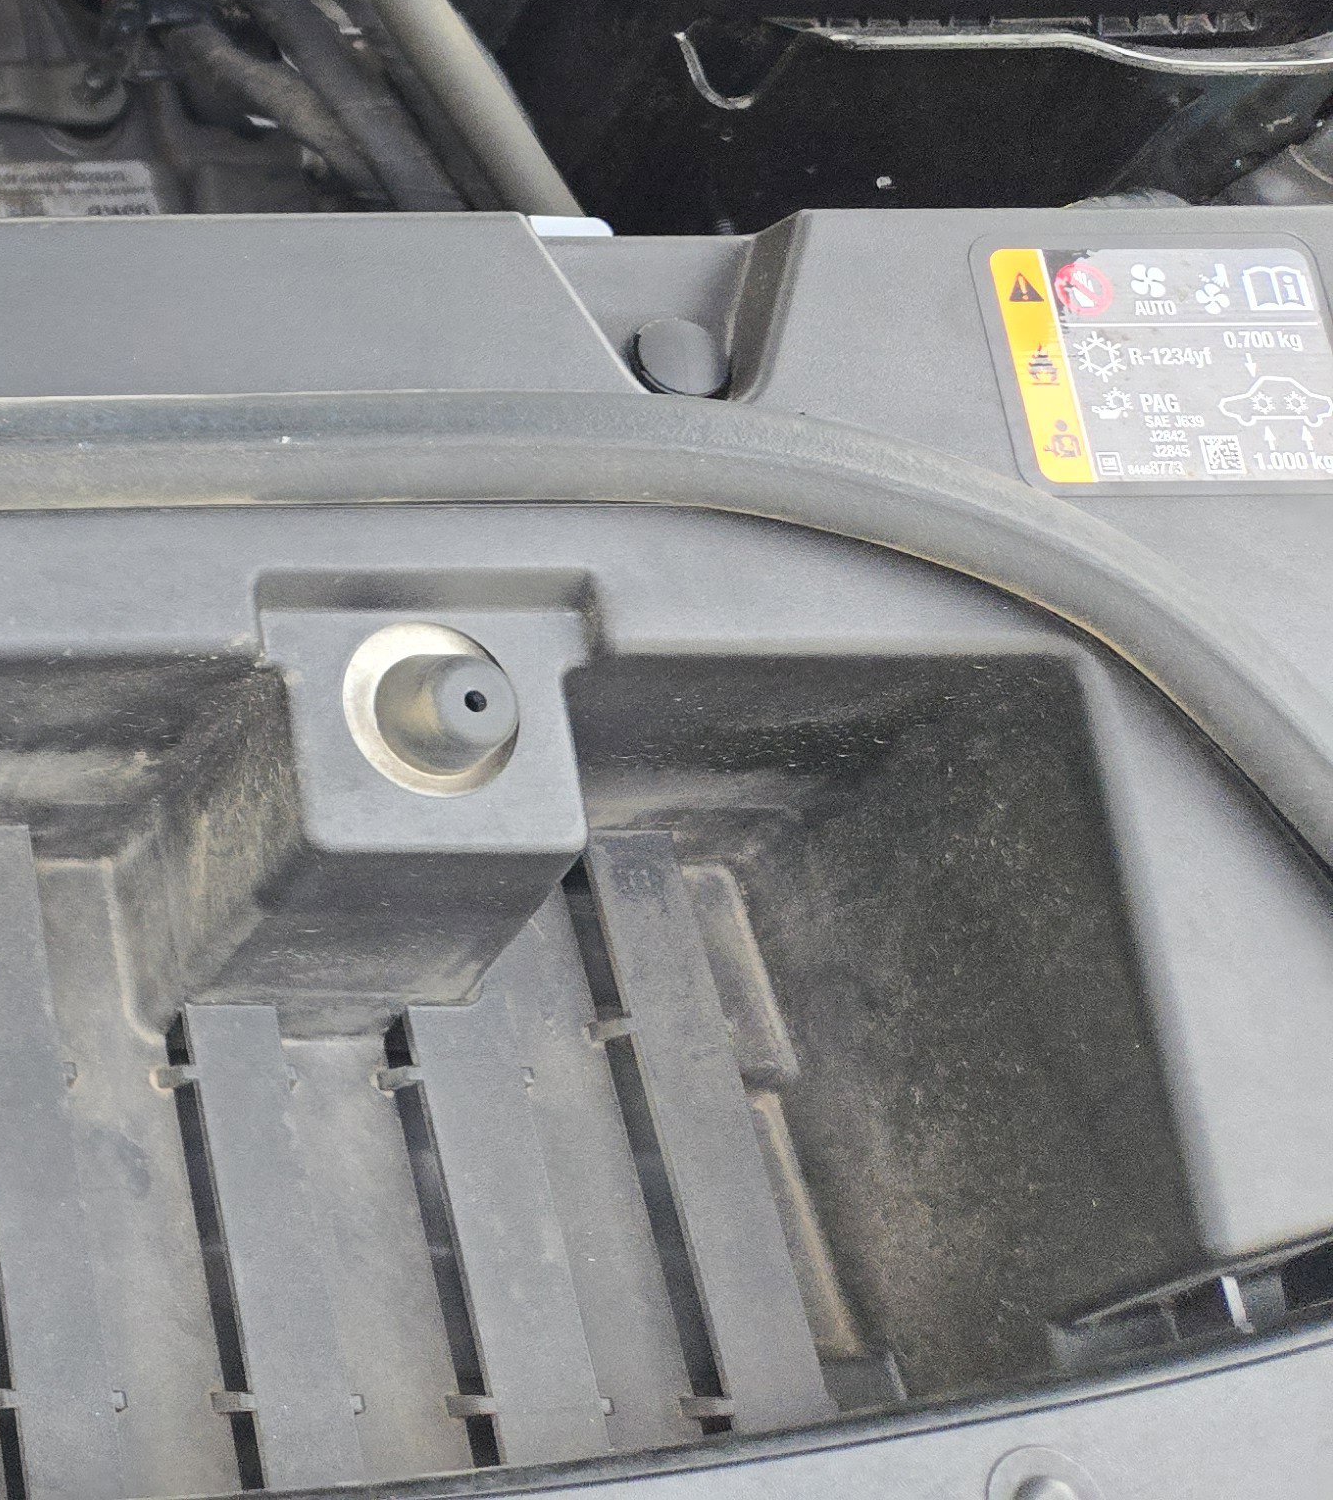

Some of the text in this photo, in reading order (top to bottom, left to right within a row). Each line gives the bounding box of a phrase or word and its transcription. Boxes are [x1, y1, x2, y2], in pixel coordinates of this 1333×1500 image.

[1135, 300, 1177, 316] AUTO
[1223, 331, 1304, 352] 0.700 kg
[1128, 347, 1213, 369] R-1234yf
[1138, 394, 1181, 413] PAG
[1144, 415, 1205, 428] SAE J639
[1149, 430, 1188, 443] J2842
[1152, 444, 1191, 458] J2845
[1253, 452, 1333, 474] 1.000 kg
